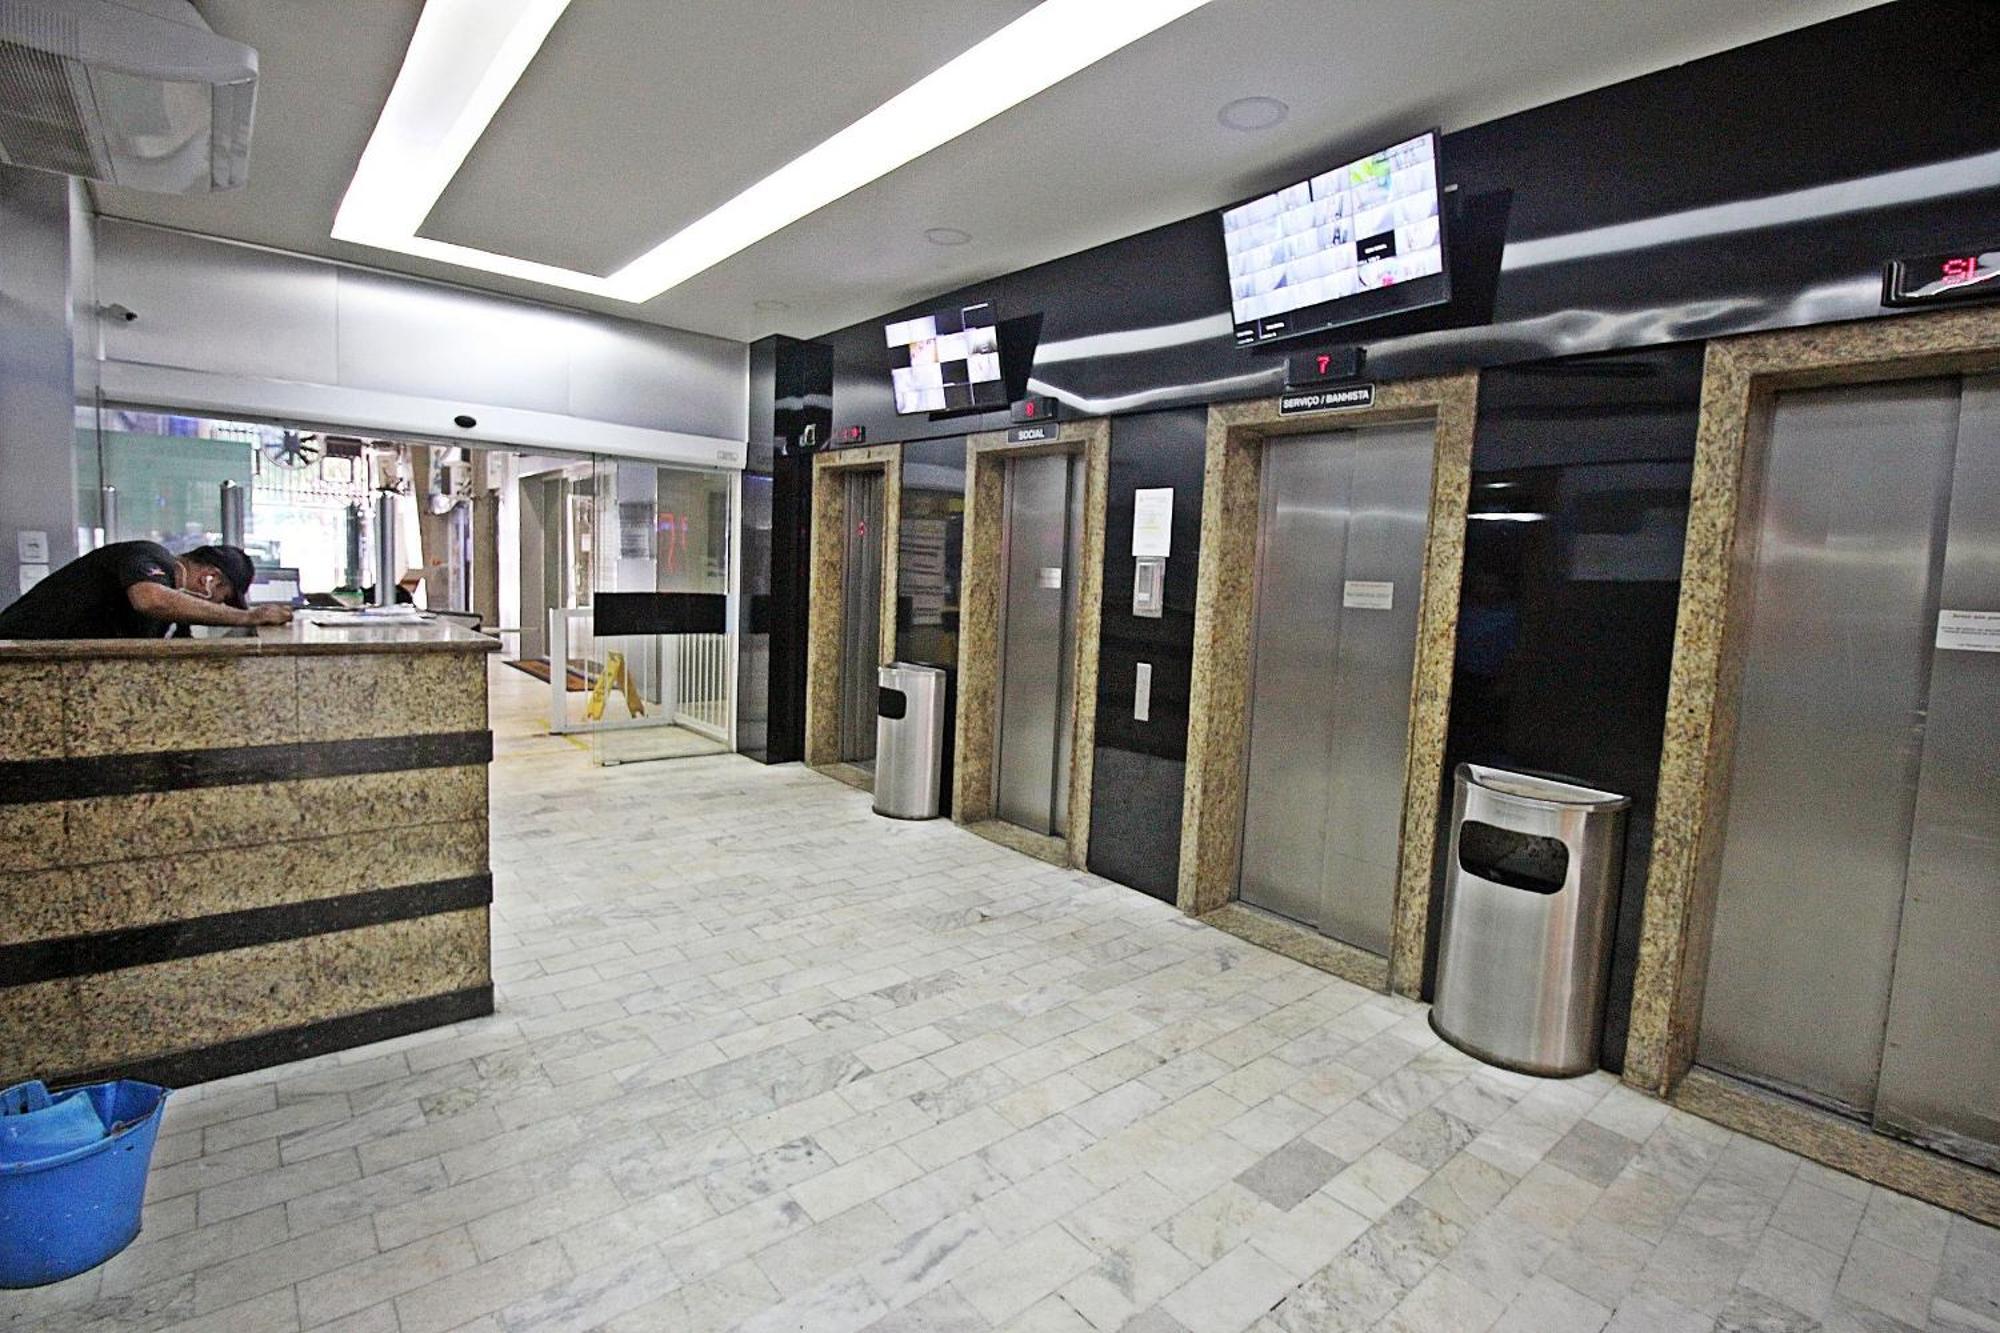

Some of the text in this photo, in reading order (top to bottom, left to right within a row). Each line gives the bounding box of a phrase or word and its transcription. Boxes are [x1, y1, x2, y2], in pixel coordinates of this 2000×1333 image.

[1316, 354, 1331, 375] 7
[1283, 395, 1320, 409] SERVIÇO
[1326, 389, 1370, 404] BANHISTA
[1018, 428, 1045, 441] SOCIAL
